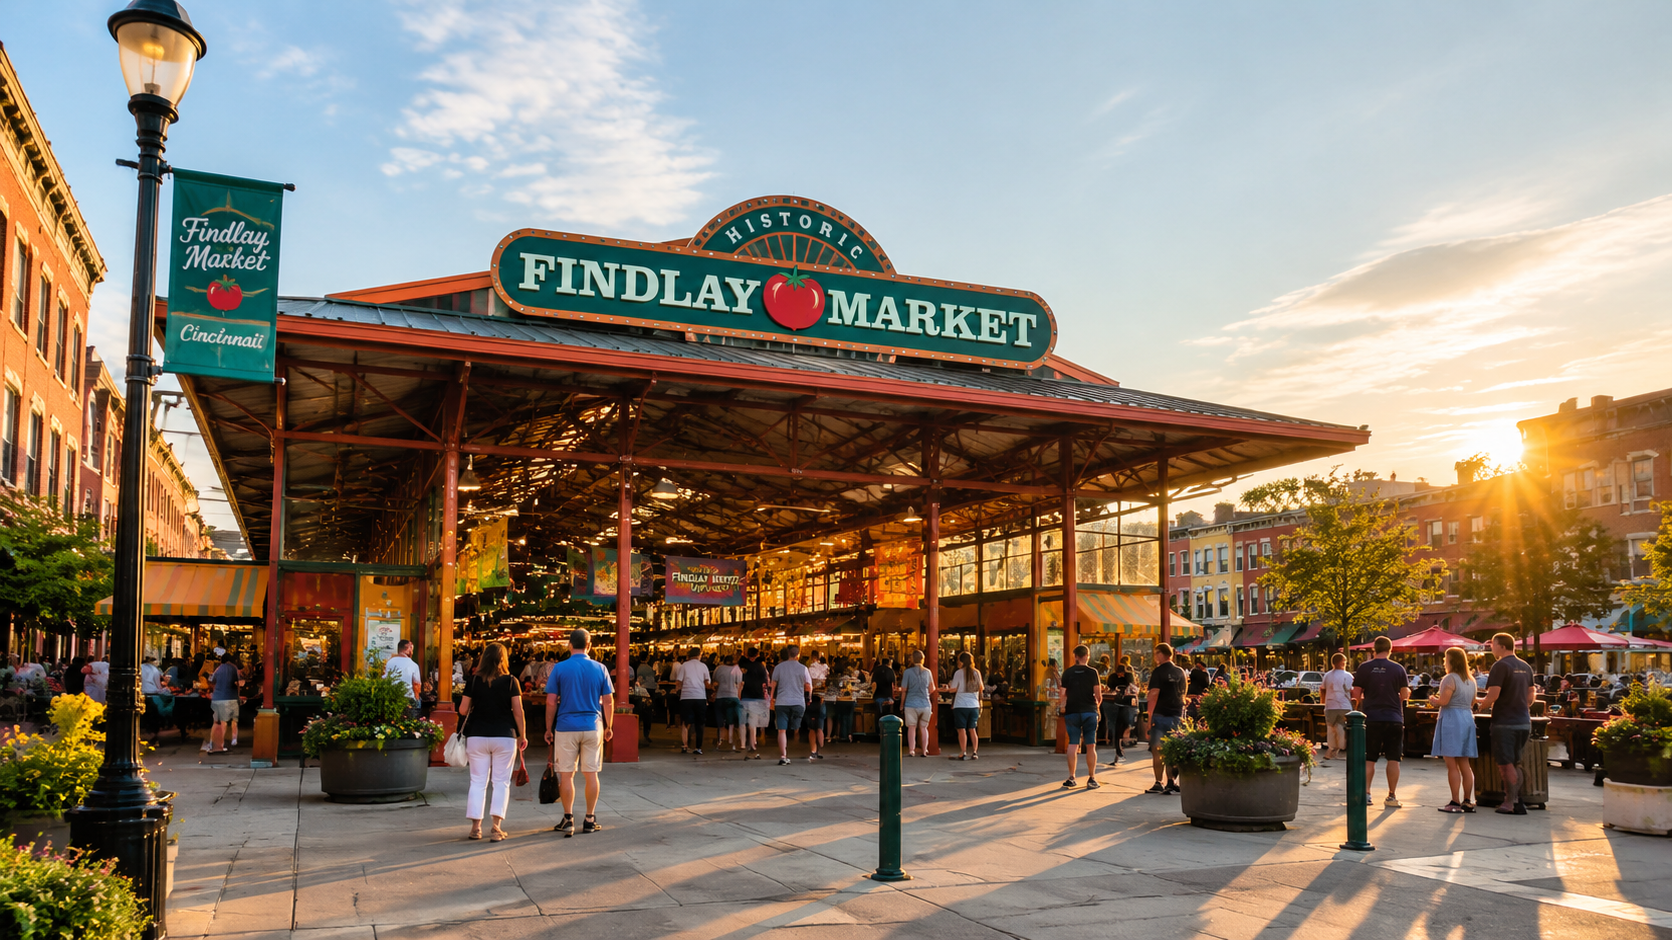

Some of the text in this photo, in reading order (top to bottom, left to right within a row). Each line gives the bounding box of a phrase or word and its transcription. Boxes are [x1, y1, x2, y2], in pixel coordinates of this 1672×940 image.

[179, 217, 270, 253] Findlay
[725, 212, 863, 259] HISTORIC
[182, 245, 271, 271] Market
[518, 252, 1037, 348] FINDLAY MARKET
